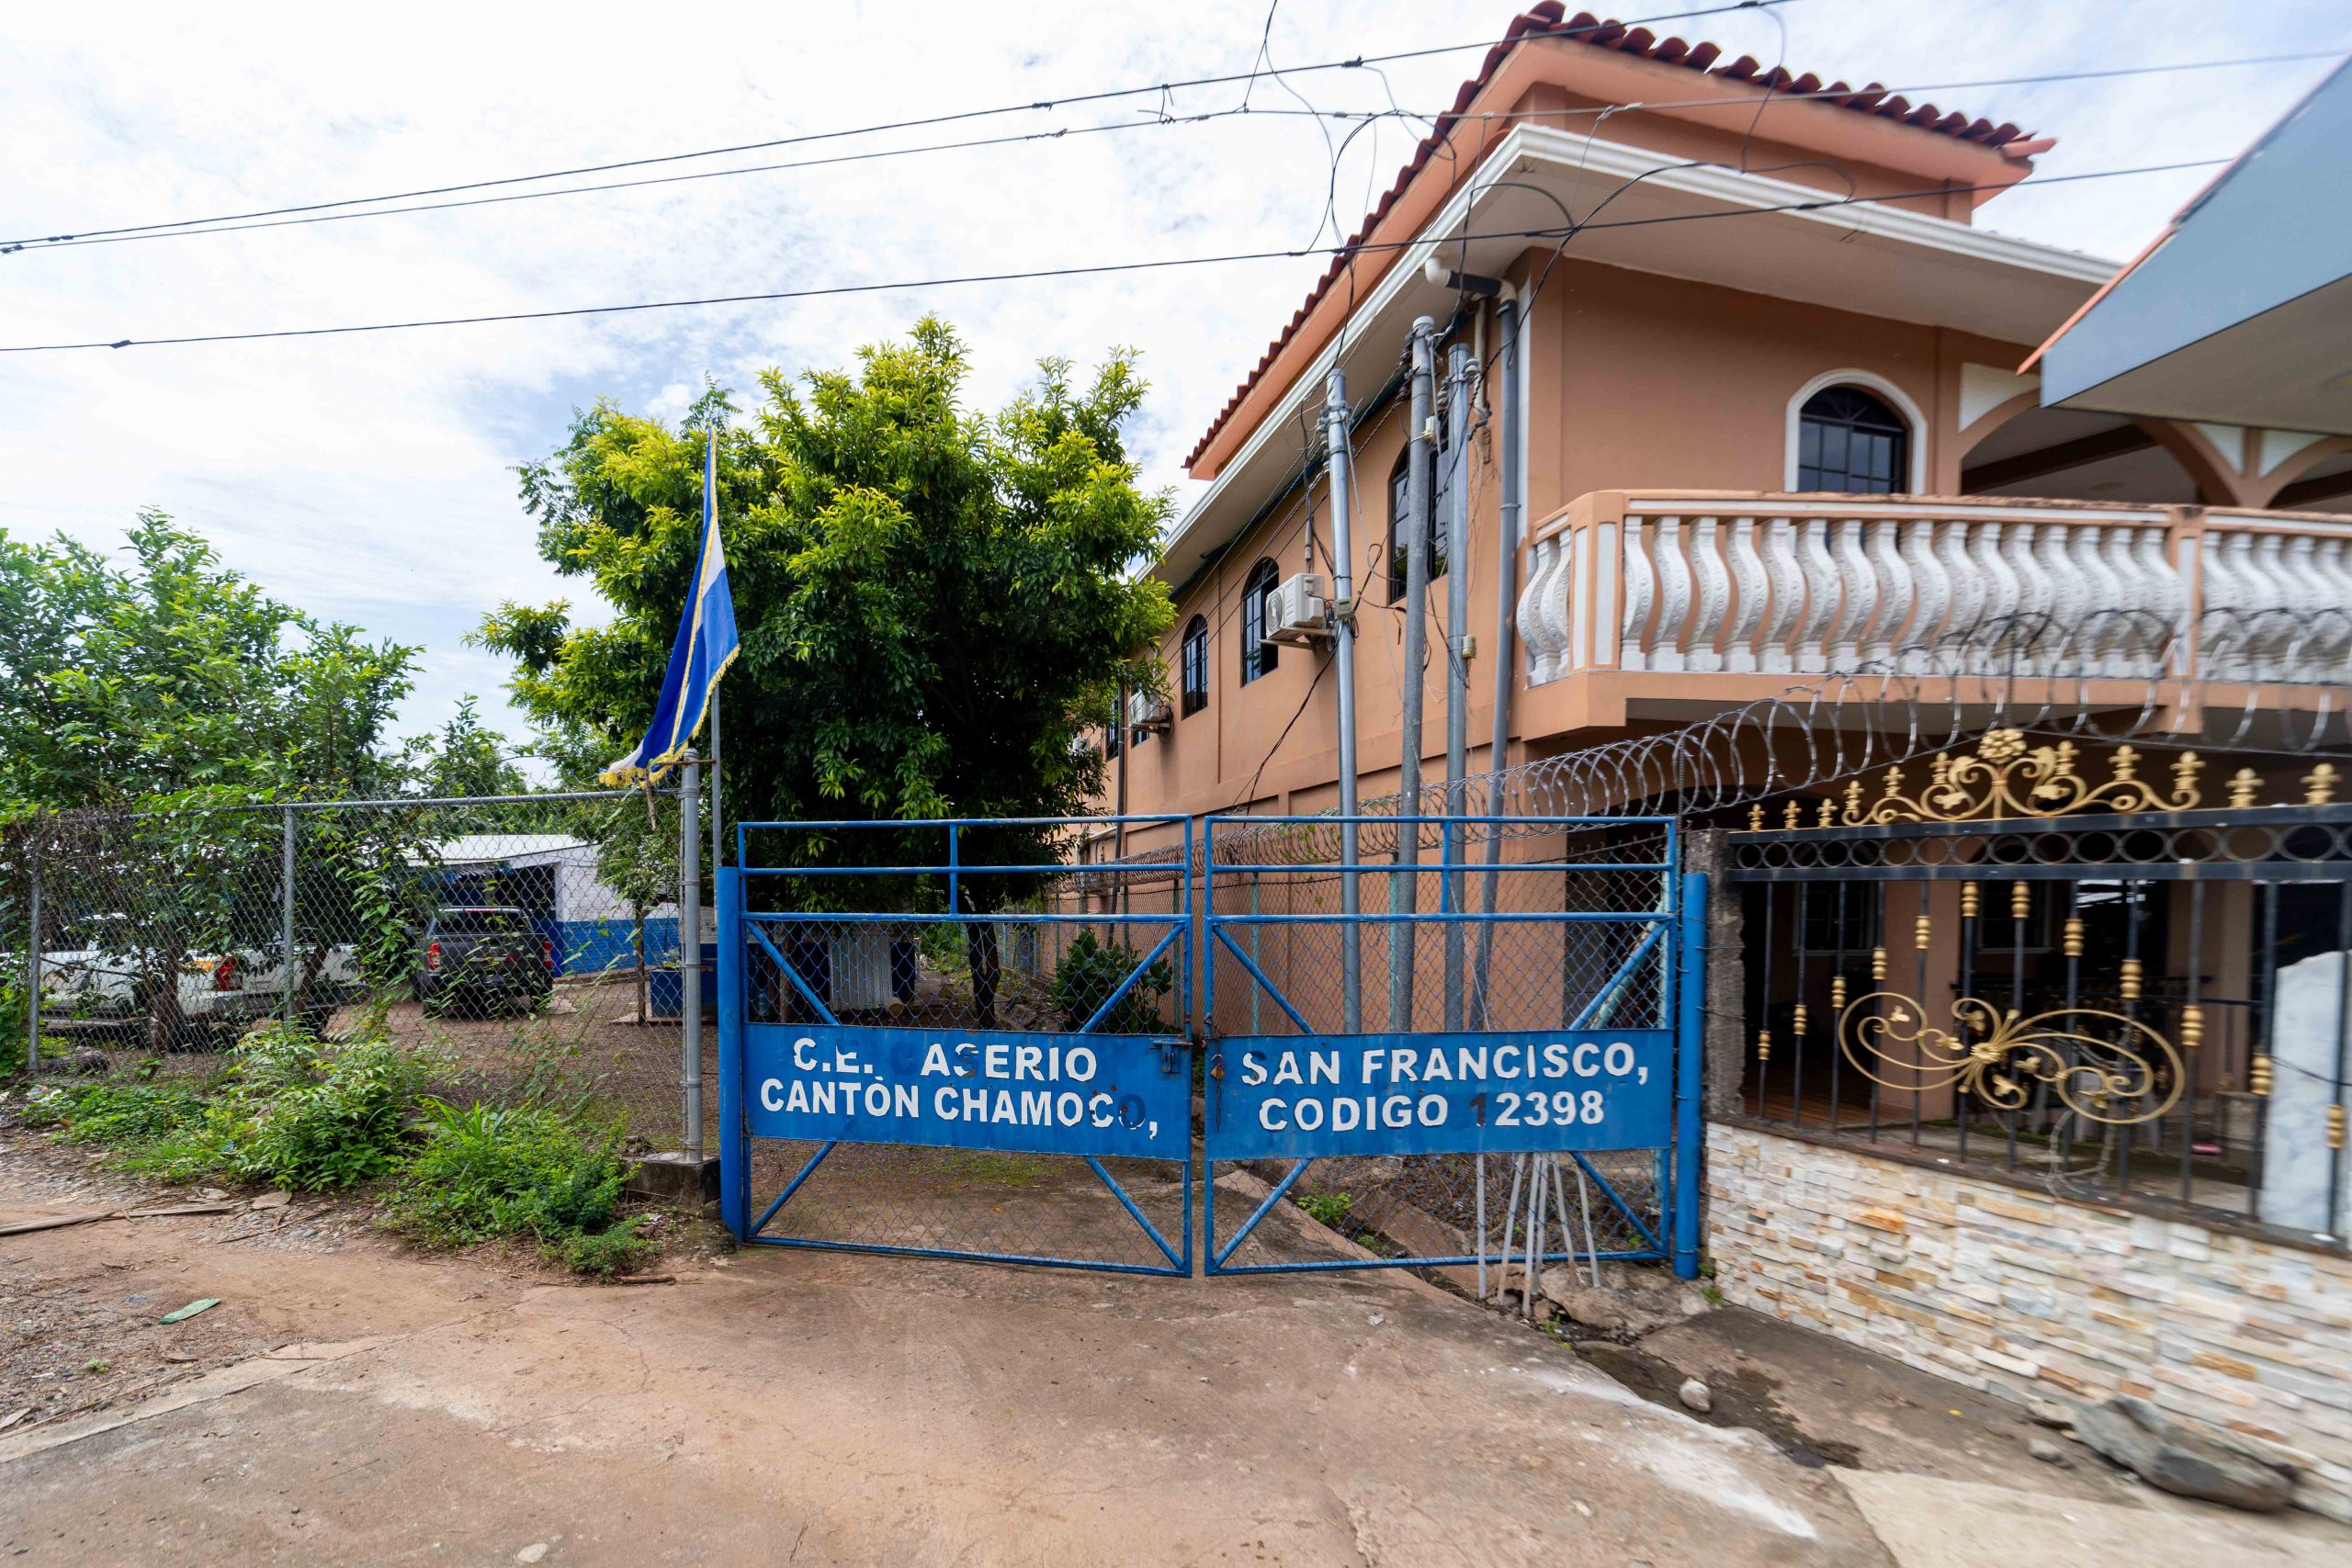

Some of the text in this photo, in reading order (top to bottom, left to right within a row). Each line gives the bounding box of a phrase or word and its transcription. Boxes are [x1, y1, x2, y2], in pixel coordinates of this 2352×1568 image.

[793, 1037, 873, 1074] C.E.
[1241, 1042, 1648, 1086] SAN FRANCISCO,
[1259, 1094, 1448, 1132] CODIGO
